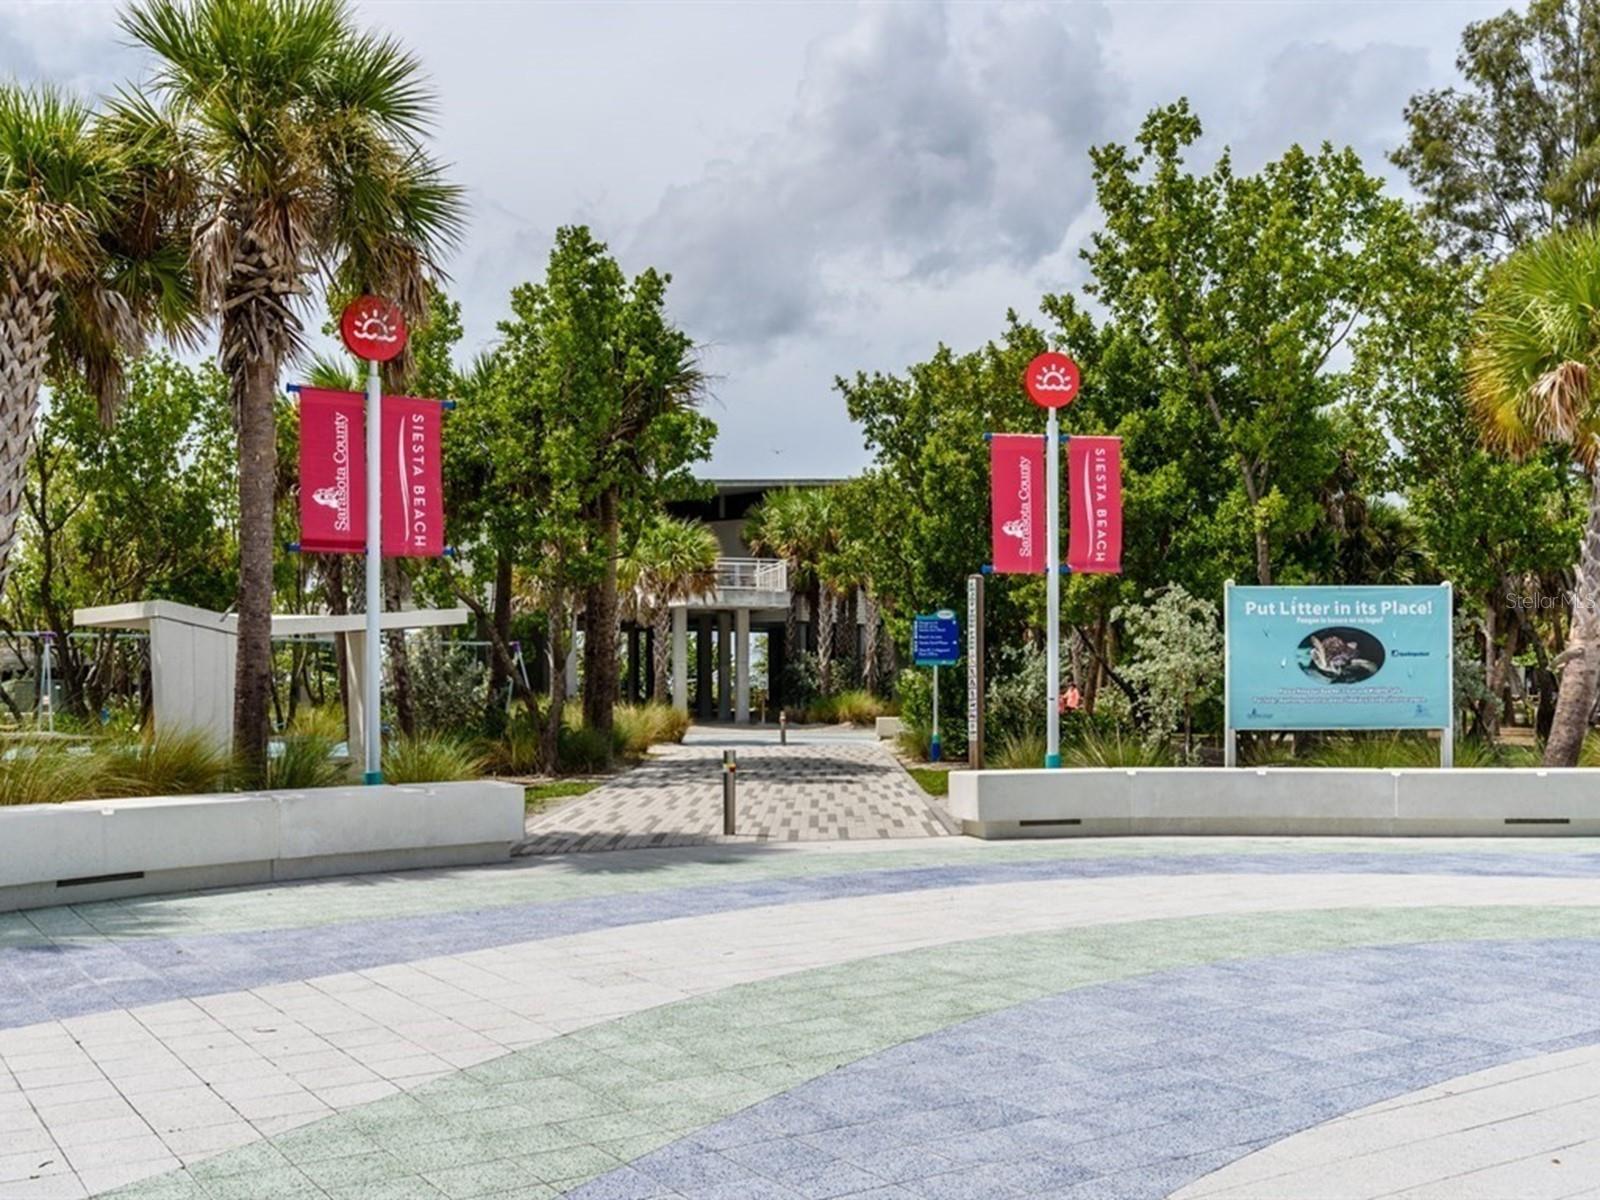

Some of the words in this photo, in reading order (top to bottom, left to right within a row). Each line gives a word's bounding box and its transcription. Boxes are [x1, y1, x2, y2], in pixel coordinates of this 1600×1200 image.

[332, 411, 349, 463] County
[412, 413, 425, 476] SIESTA
[334, 467, 348, 531] Sarasota
[1018, 455, 1032, 500] County
[1095, 448, 1107, 501] SIESTA
[413, 485, 427, 547] BEACH
[1095, 509, 1108, 562] BEACH
[1245, 601, 1276, 616] Put
[1280, 597, 1330, 616] Litter
[1334, 601, 1351, 616] in
[1355, 601, 1377, 616] its
[1380, 601, 1433, 616] Place!
